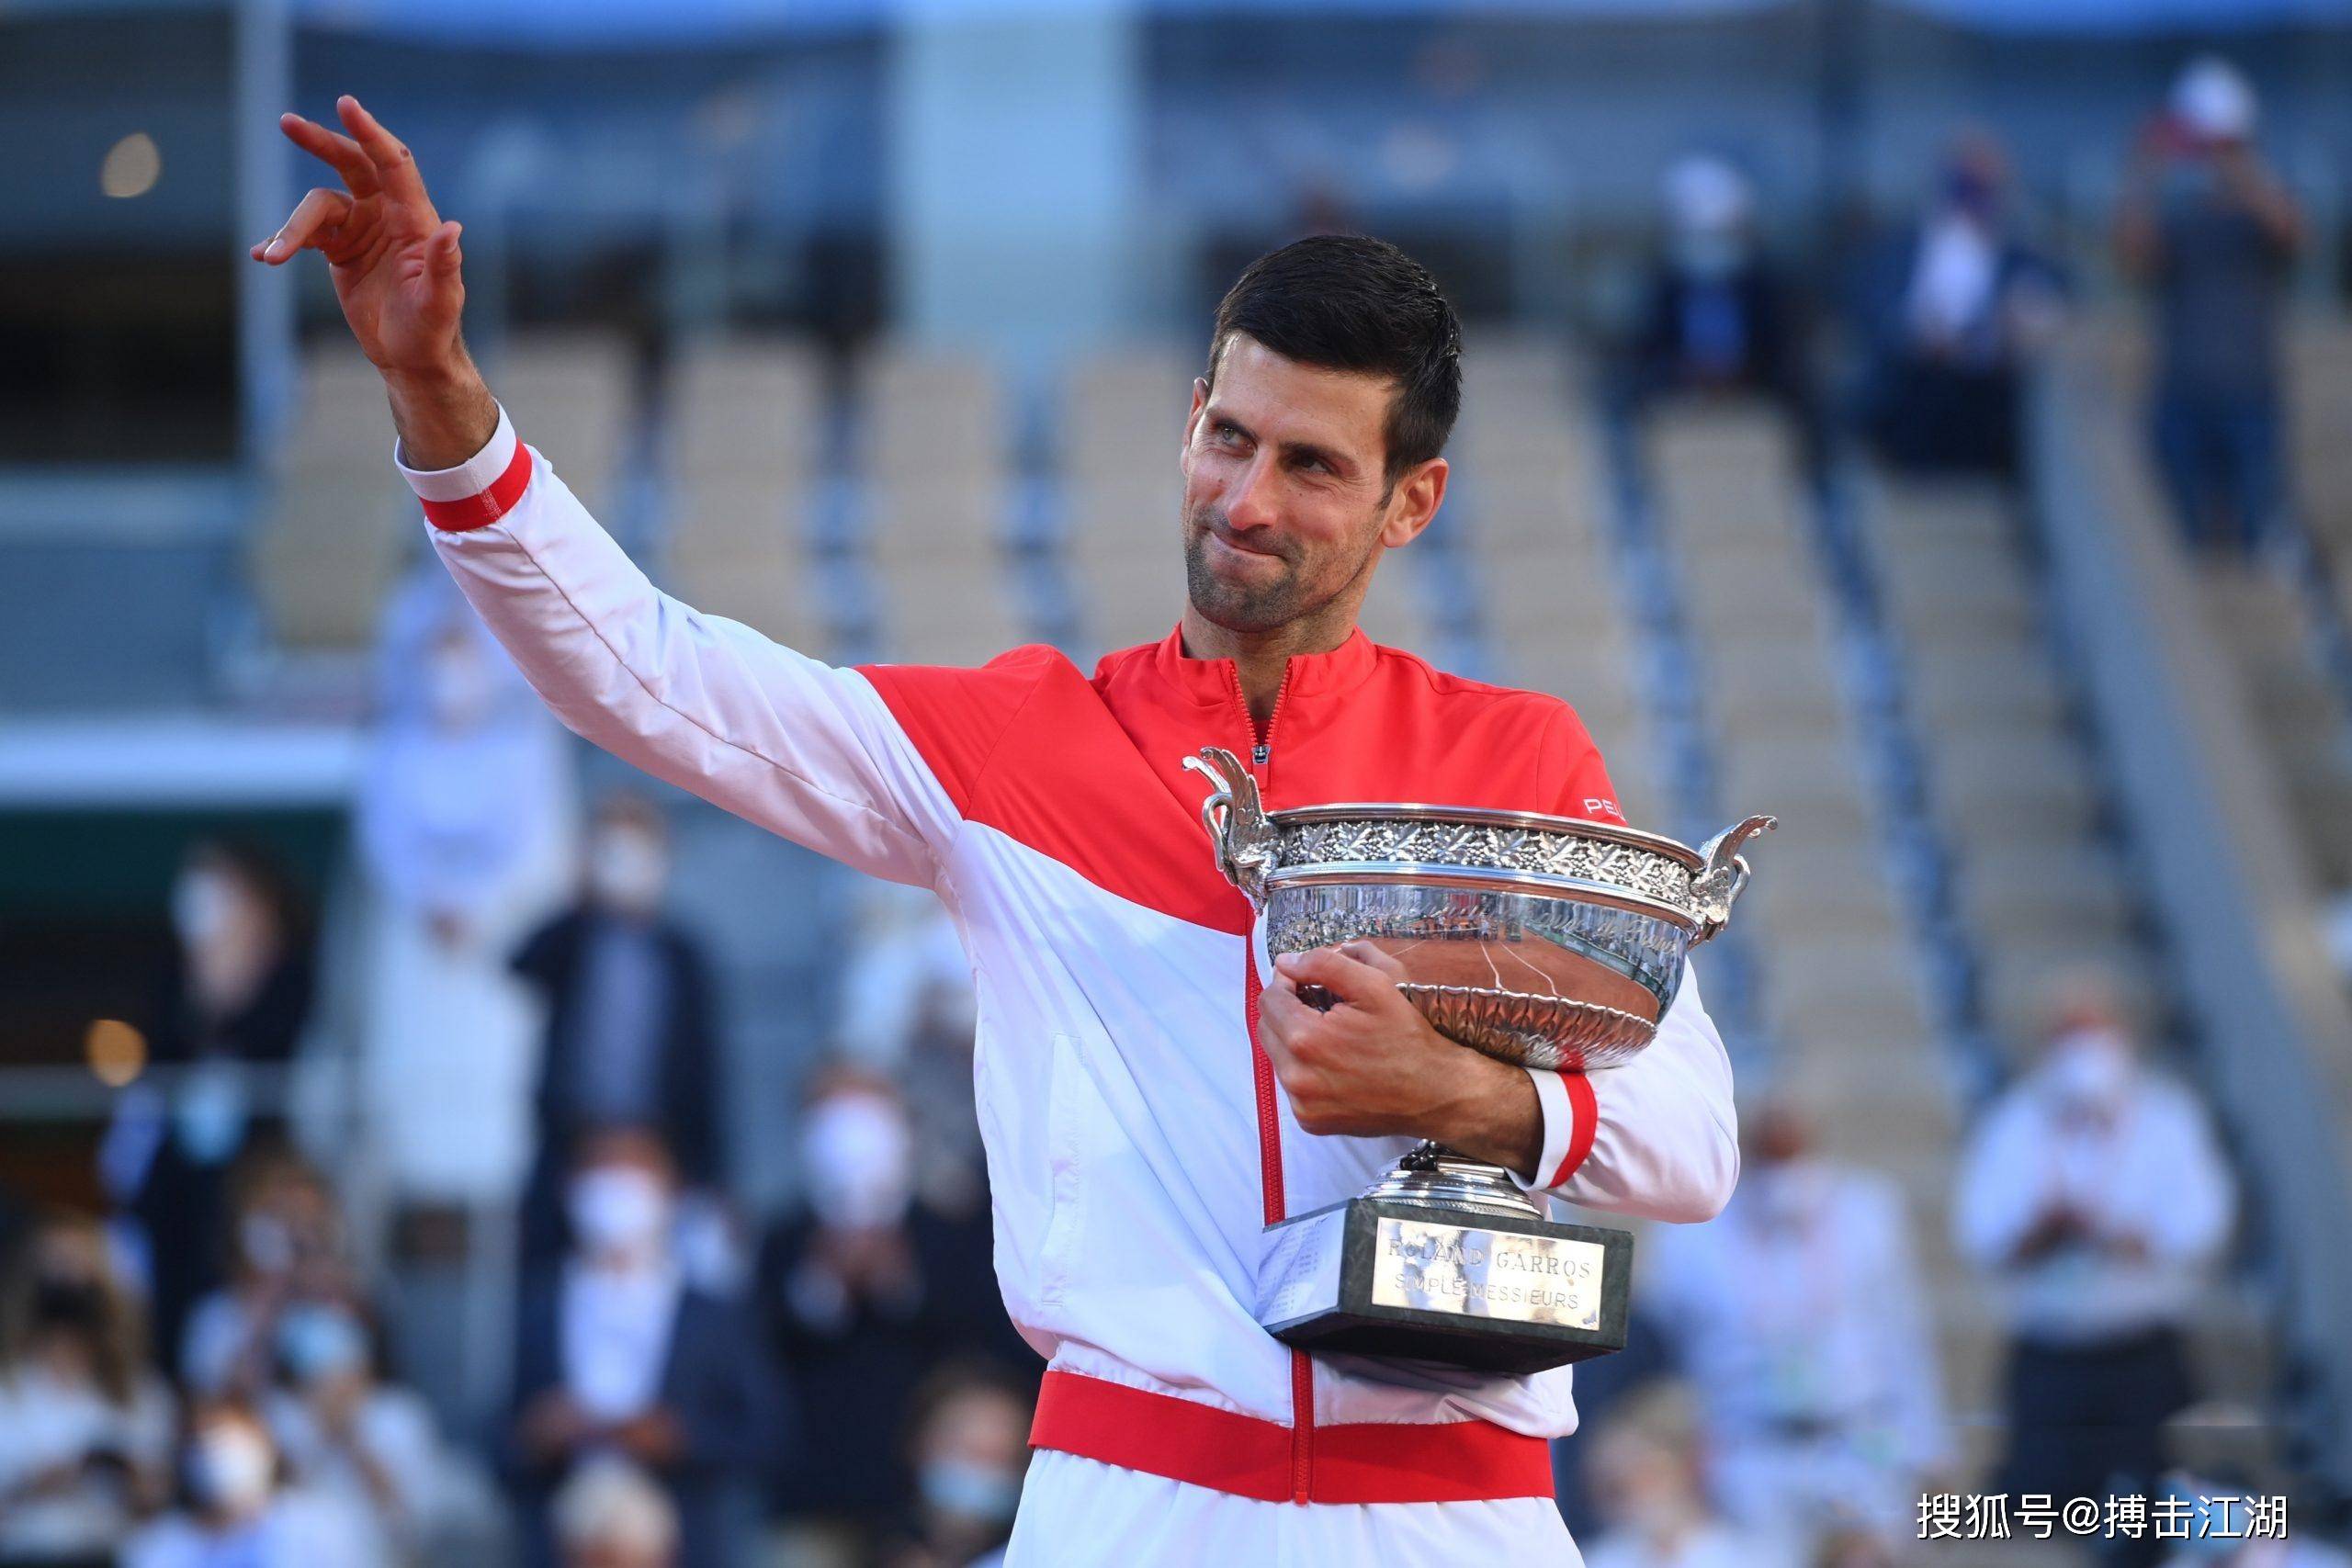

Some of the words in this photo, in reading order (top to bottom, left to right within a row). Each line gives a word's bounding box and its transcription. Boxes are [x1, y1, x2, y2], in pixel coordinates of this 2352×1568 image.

[1387, 1237, 1485, 1268] ROLAND
[1496, 1250, 1591, 1280] GARROS
[1393, 1272, 1463, 1297] SIMPLE
[1470, 1283, 1580, 1310] MESSIEURS
